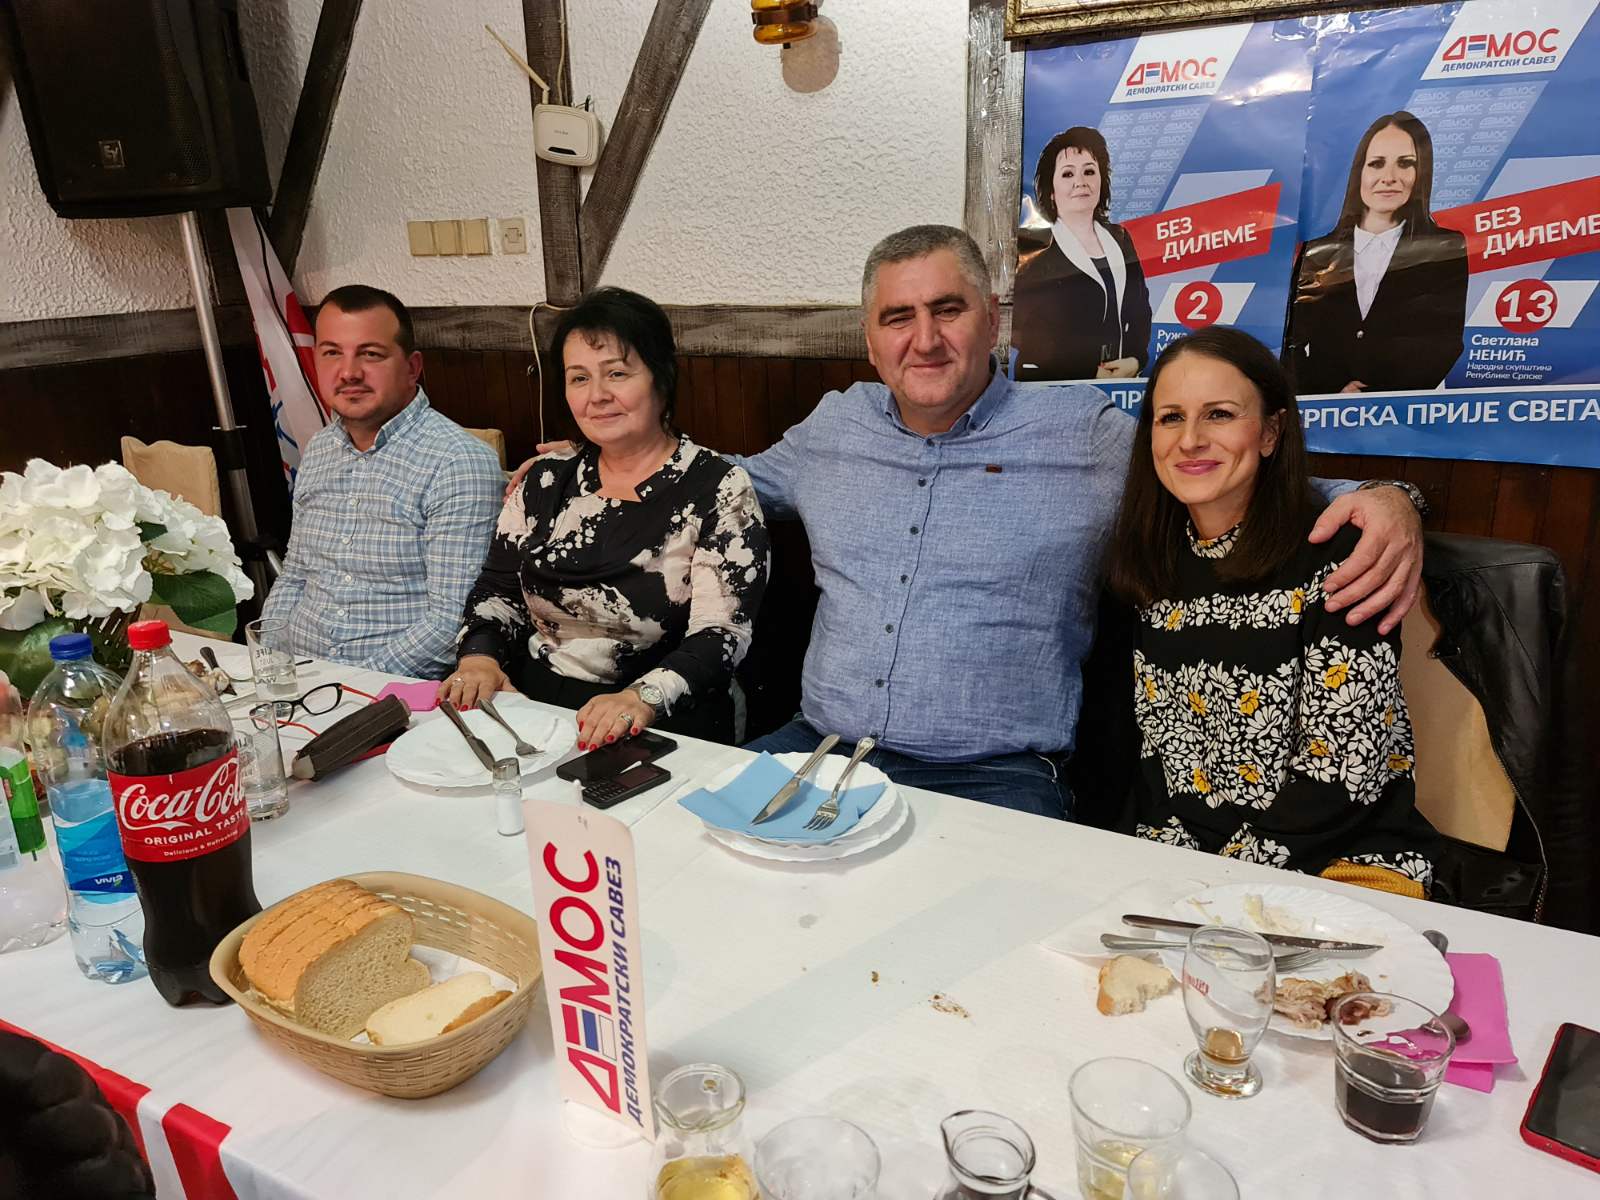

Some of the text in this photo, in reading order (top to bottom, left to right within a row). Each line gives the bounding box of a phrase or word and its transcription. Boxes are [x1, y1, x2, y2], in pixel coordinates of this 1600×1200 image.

[1441, 55, 1557, 73] ДЕМОКРАТСКИ САВЕЗ
[1126, 83, 1188, 97] ДЕМОКРАТСКИ
[1156, 216, 1193, 240] БЕЗ
[1475, 206, 1521, 233] БЕЗ
[1162, 223, 1257, 263] ДИЛЕМЕ
[1483, 214, 1600, 259] ДИЛЕМЕ
[1187, 291, 1209, 320] 2
[1501, 289, 1553, 323] 13
[1471, 334, 1539, 346] Светлана
[1467, 362, 1553, 372] Народна скупштина
[1469, 349, 1526, 361] НЕНИЋ
[1465, 370, 1543, 380] Републике Српске
[1298, 398, 1600, 429] РПСКА ПРИЈЕ СВЕГА
[144, 827, 213, 846] ORIGINAL
[605, 856, 644, 1128] ДЕМОКРАТСКИ САВЕЗ
